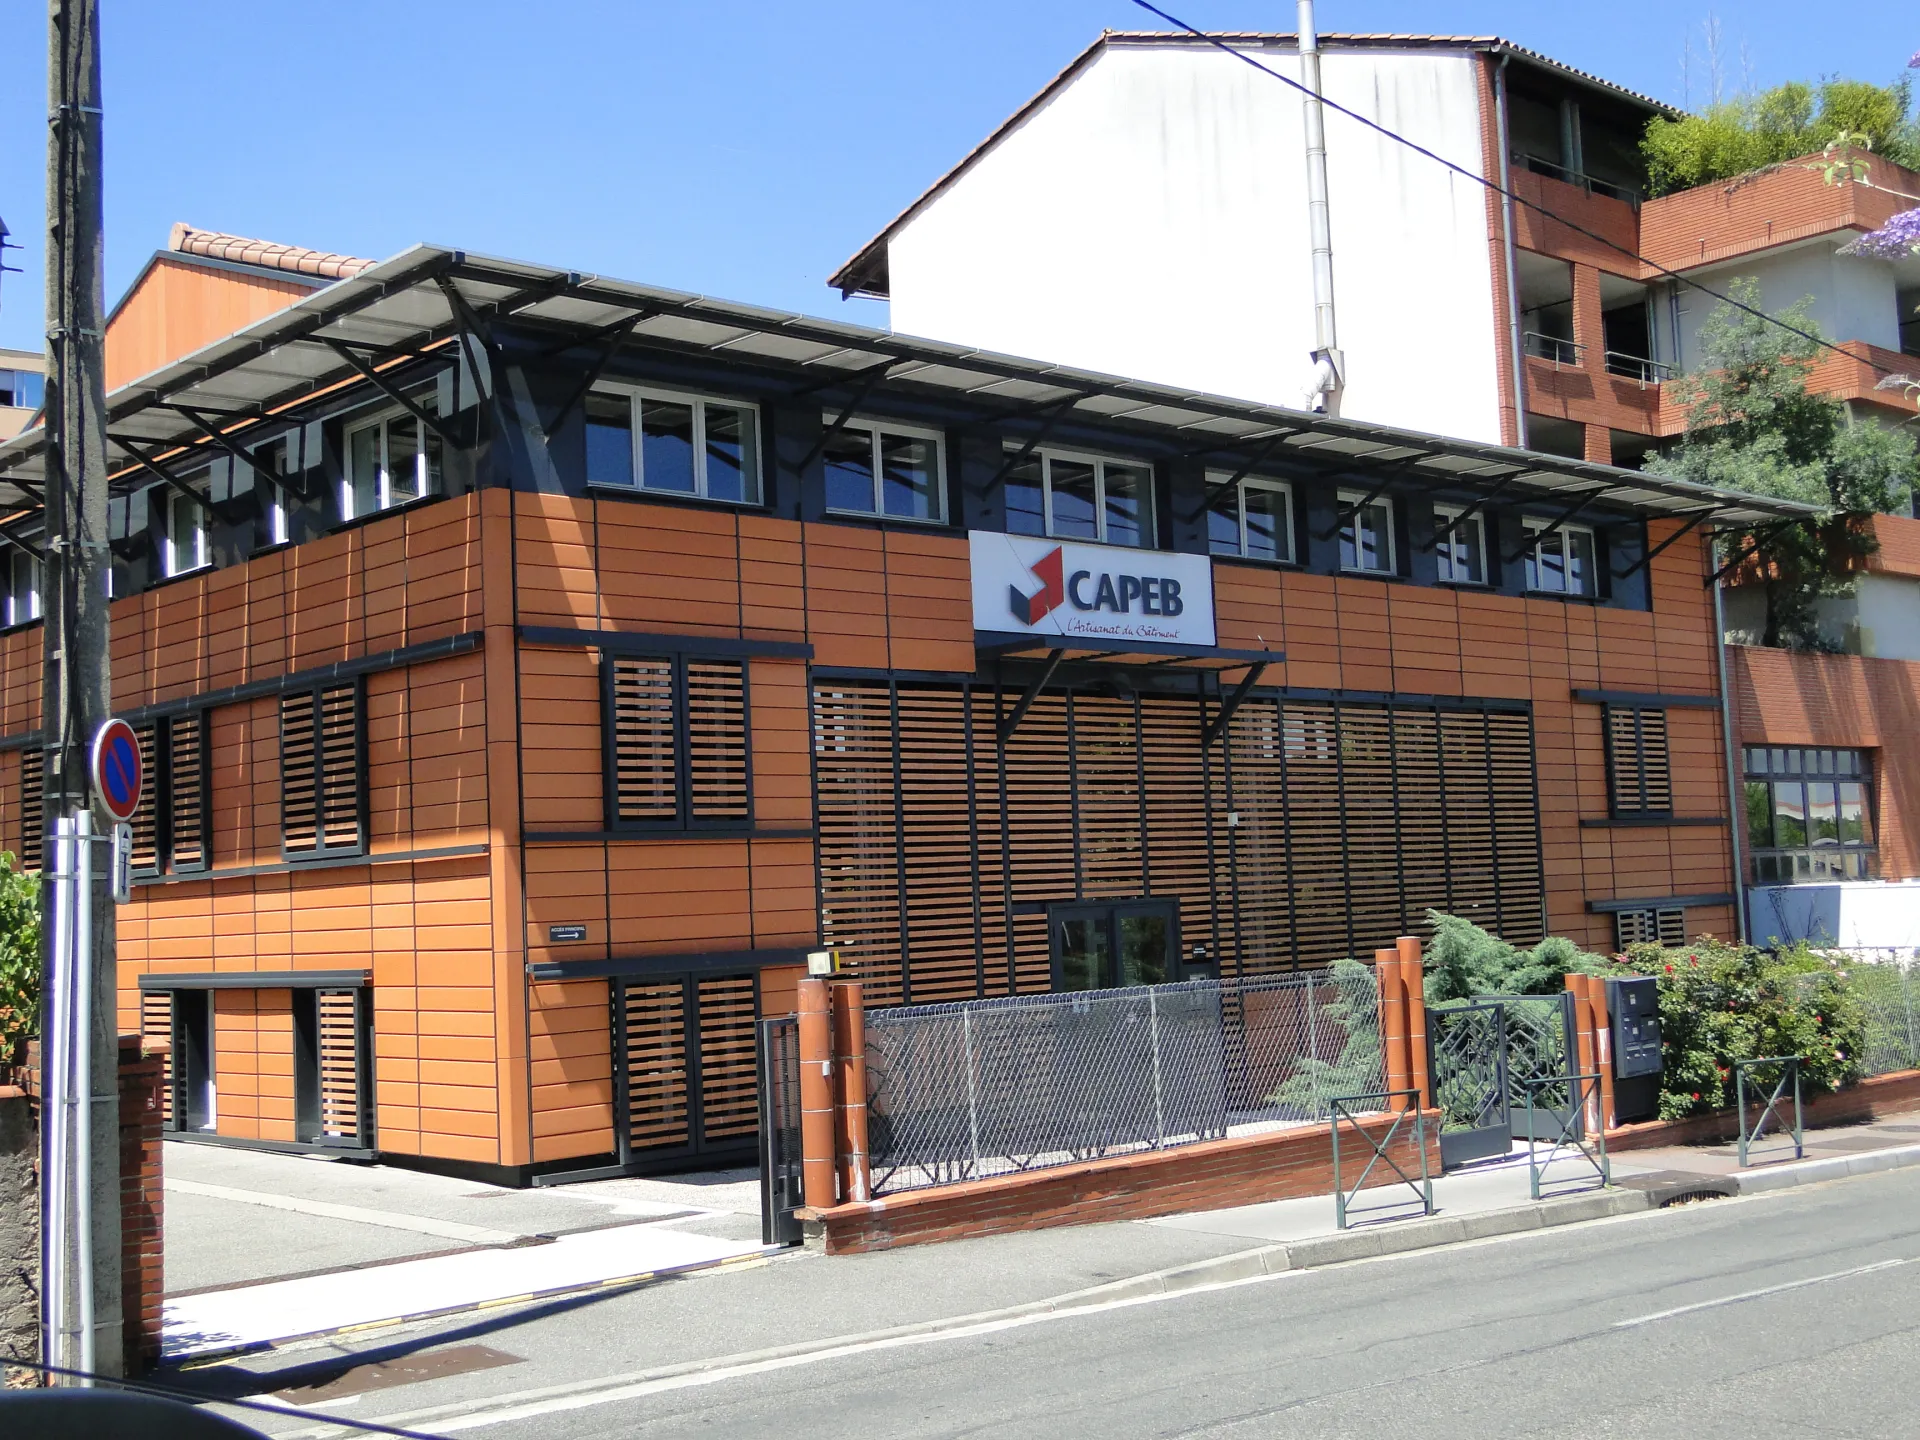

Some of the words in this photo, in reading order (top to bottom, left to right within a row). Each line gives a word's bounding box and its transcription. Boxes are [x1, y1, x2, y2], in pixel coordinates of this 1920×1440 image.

[1068, 570, 1183, 617] CAPEB
[1122, 624, 1134, 636] du
[1136, 624, 1181, 639] Bâtiment
